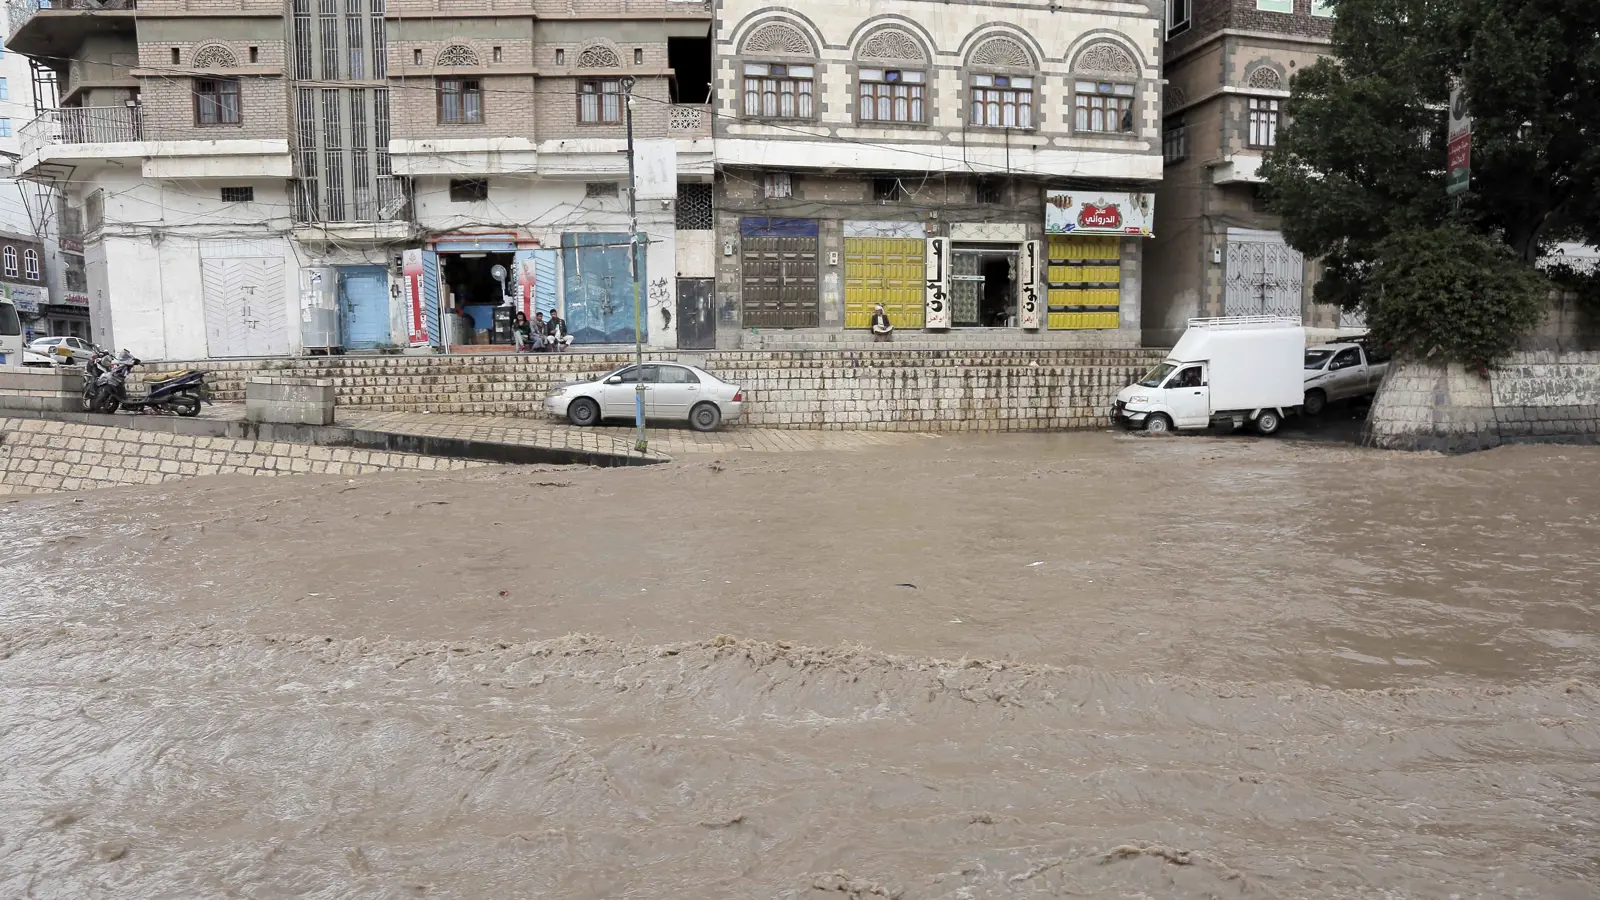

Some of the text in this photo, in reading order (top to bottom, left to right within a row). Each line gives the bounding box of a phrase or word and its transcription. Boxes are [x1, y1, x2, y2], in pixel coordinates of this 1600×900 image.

[1085, 215, 1115, 225] الدرواني
[926, 239, 947, 312] صالون
[1023, 242, 1037, 312] صالون
